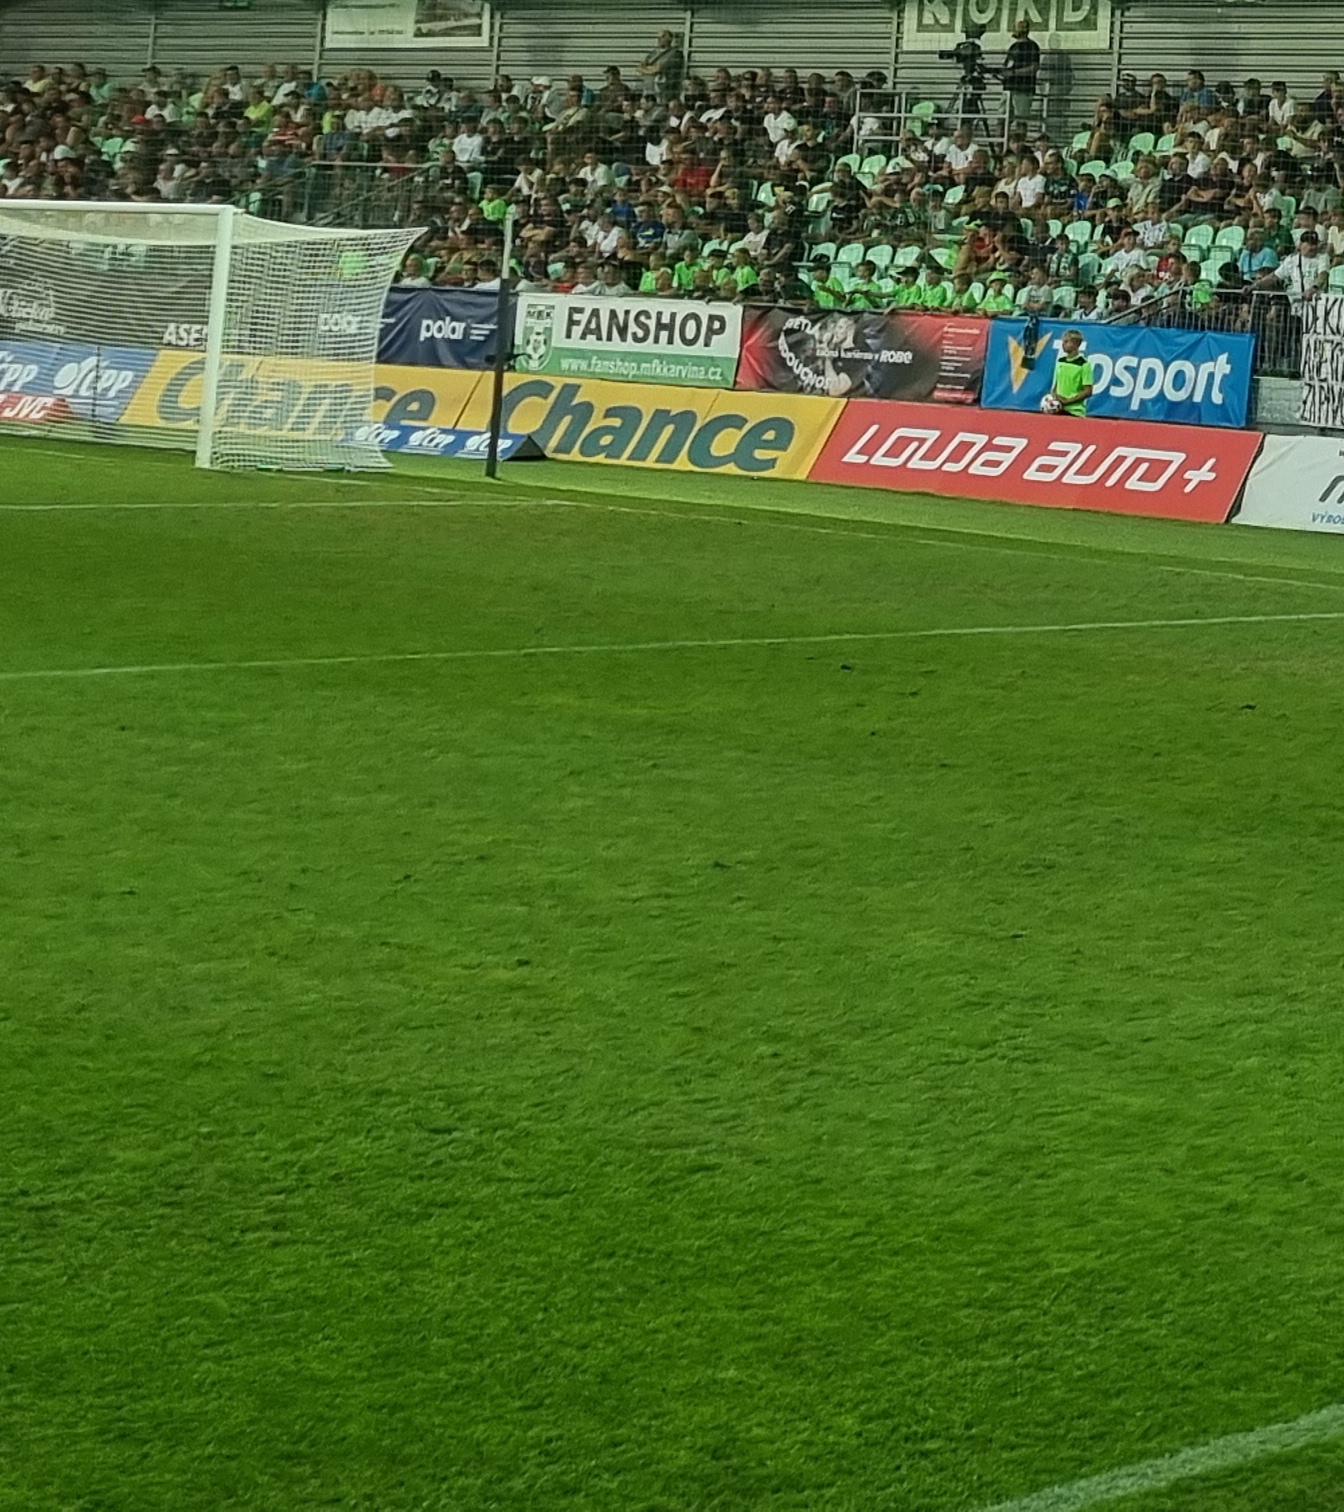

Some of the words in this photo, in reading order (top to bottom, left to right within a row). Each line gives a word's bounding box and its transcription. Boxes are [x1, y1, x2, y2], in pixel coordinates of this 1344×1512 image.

[162, 322, 208, 348] ASE
[419, 316, 467, 342] polar
[564, 305, 727, 348] FANSHOP
[1053, 338, 1232, 410] psport
[501, 378, 796, 473] Chance
[842, 424, 1029, 476] LOUDA
